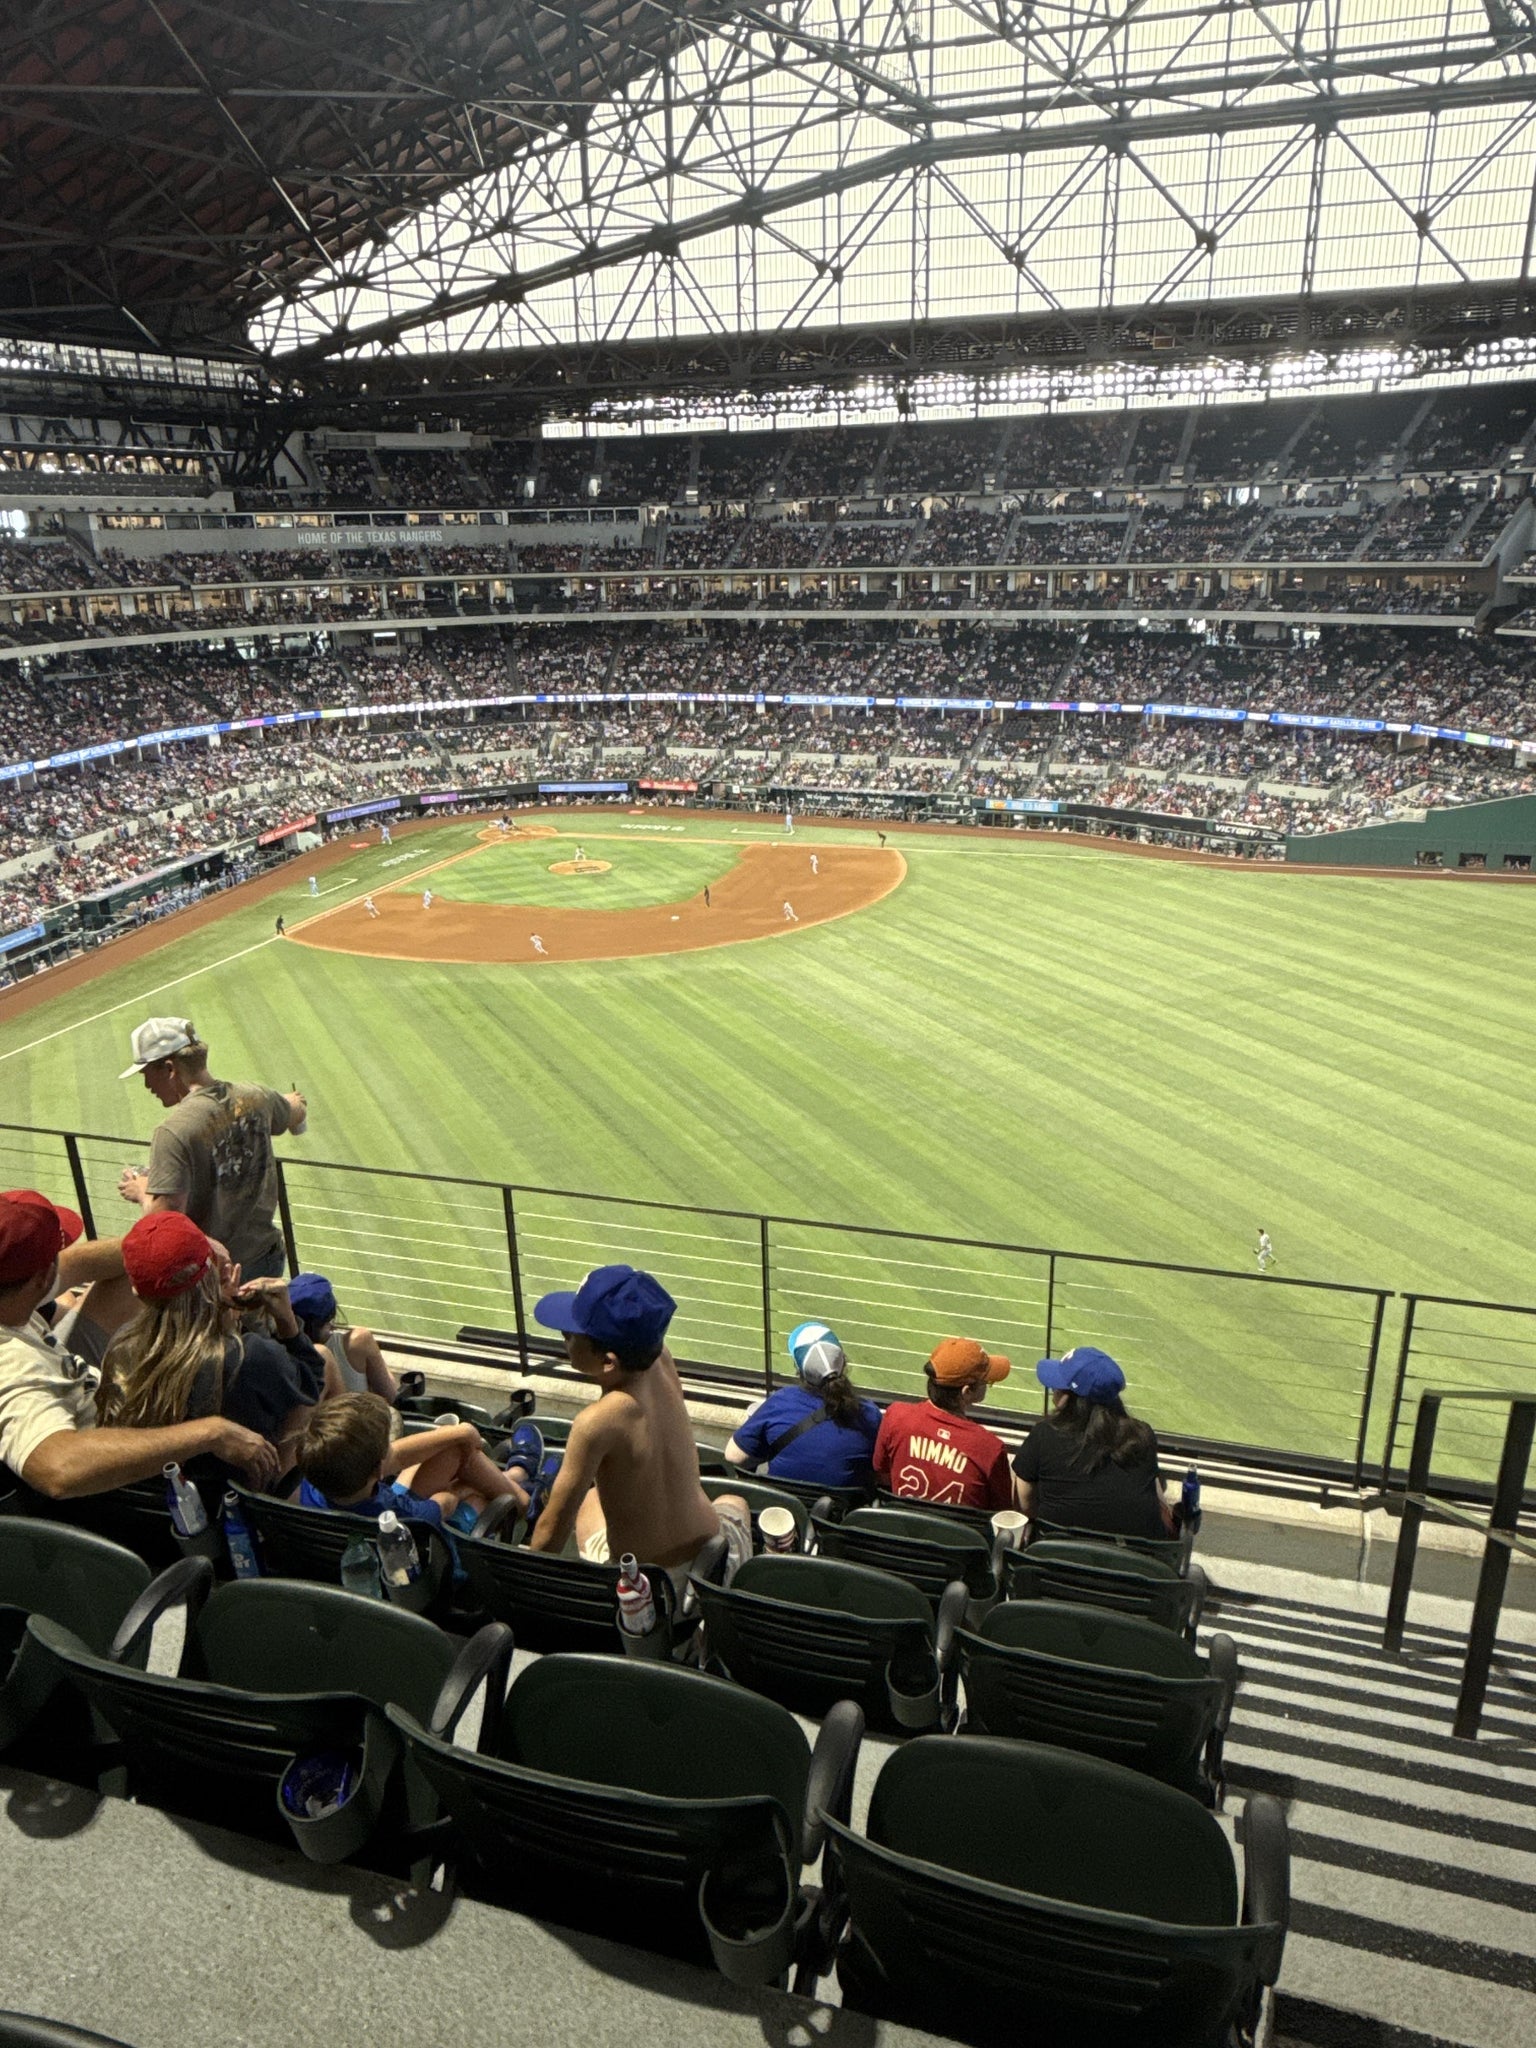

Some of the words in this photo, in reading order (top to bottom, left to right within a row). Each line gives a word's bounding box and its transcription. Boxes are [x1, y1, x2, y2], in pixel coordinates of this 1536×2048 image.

[297, 532, 327, 545] HOME
[330, 532, 343, 544] OF
[346, 531, 364, 544] THE
[366, 530, 397, 543] TEXAS
[399, 530, 443, 543] RANGERS
[909, 1435, 968, 1474] NIMMO
[897, 1464, 965, 1505] 24
